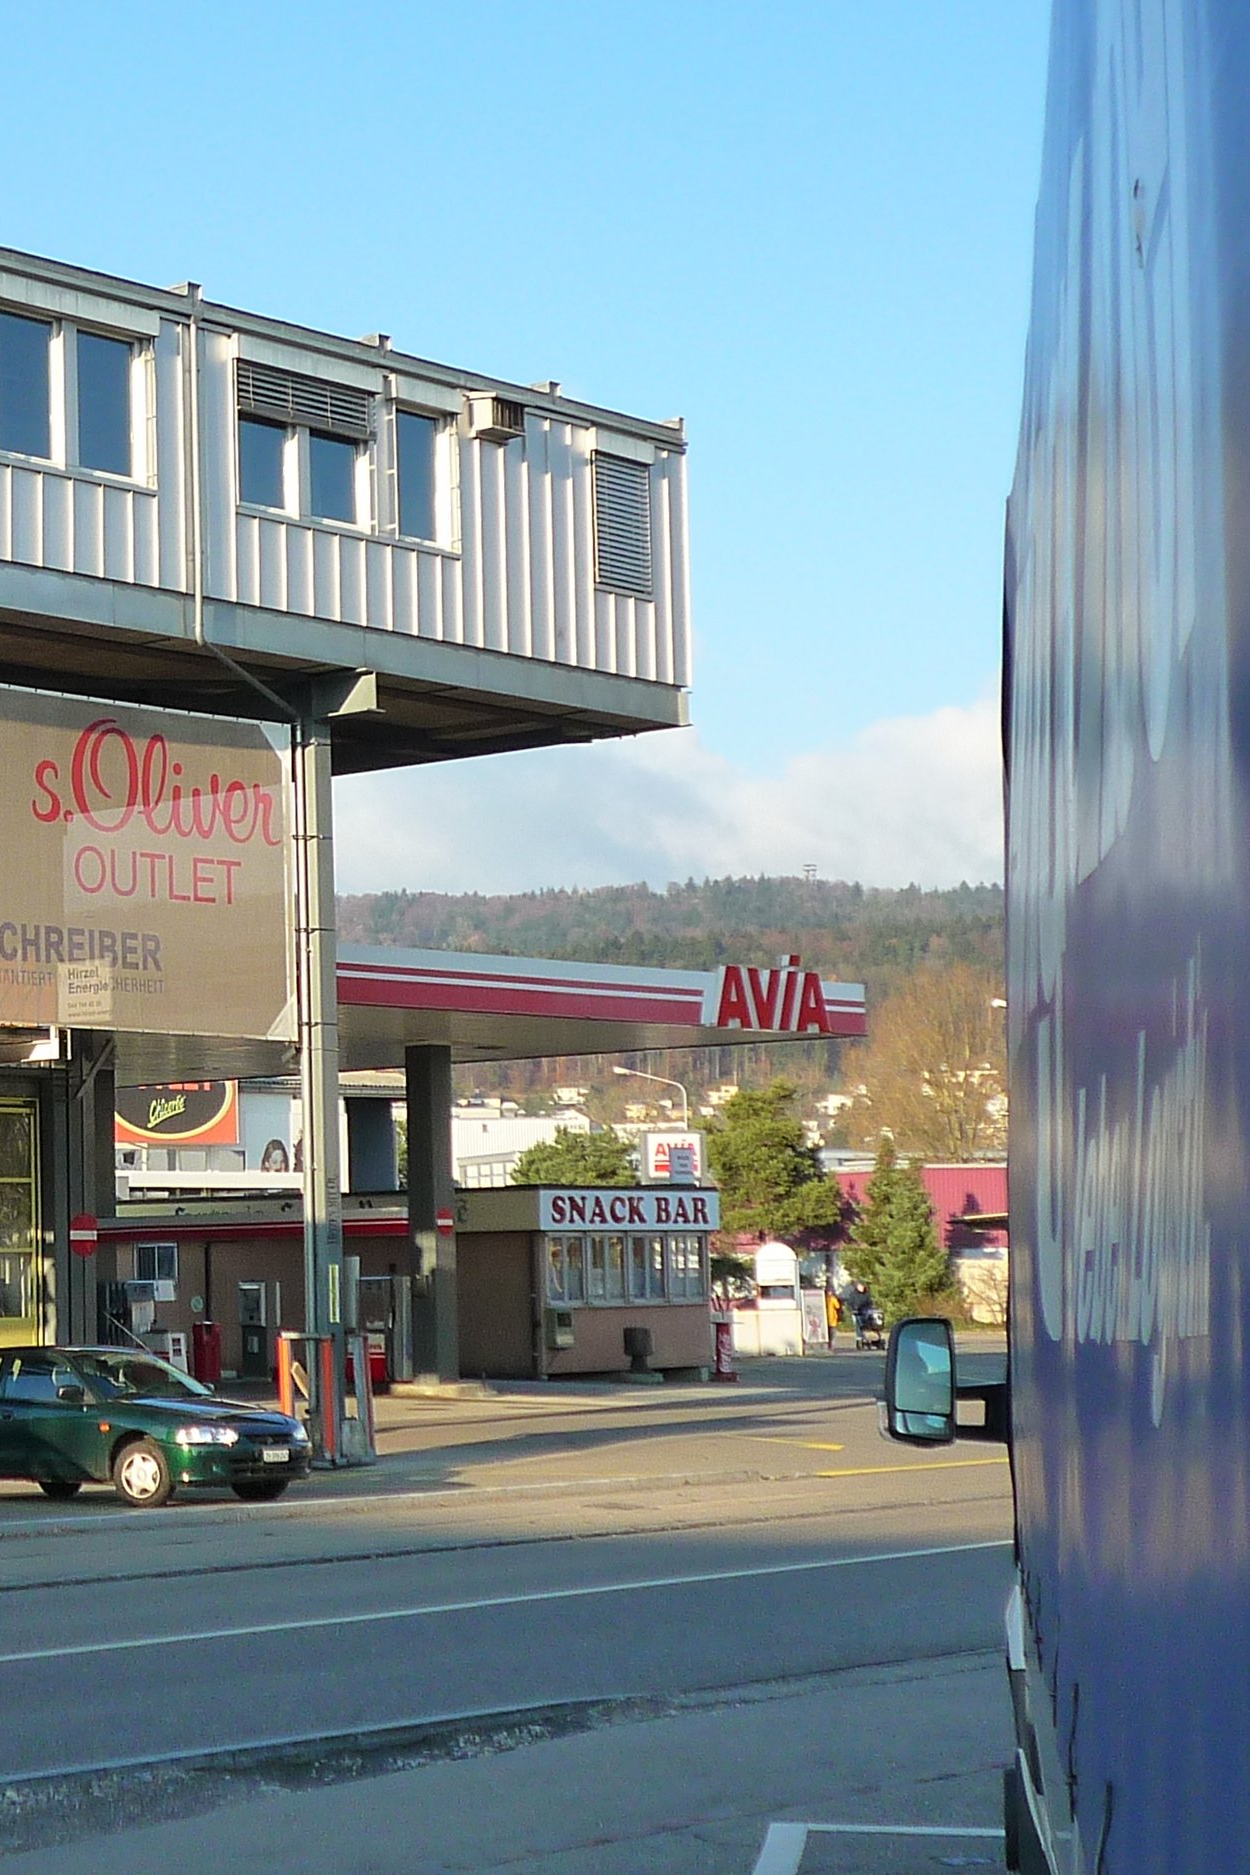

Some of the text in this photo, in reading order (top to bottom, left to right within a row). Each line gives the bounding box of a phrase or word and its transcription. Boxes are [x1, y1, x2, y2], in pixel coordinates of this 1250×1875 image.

[31, 717, 283, 847] s.Oliver
[74, 845, 242, 905] OUTLET
[67, 966, 99, 982] Hirzel
[67, 981, 109, 996] Energie
[110, 976, 165, 995] CHERHEIT
[716, 954, 833, 1035] AVIA
[550, 1194, 710, 1225] SNACK BAR
